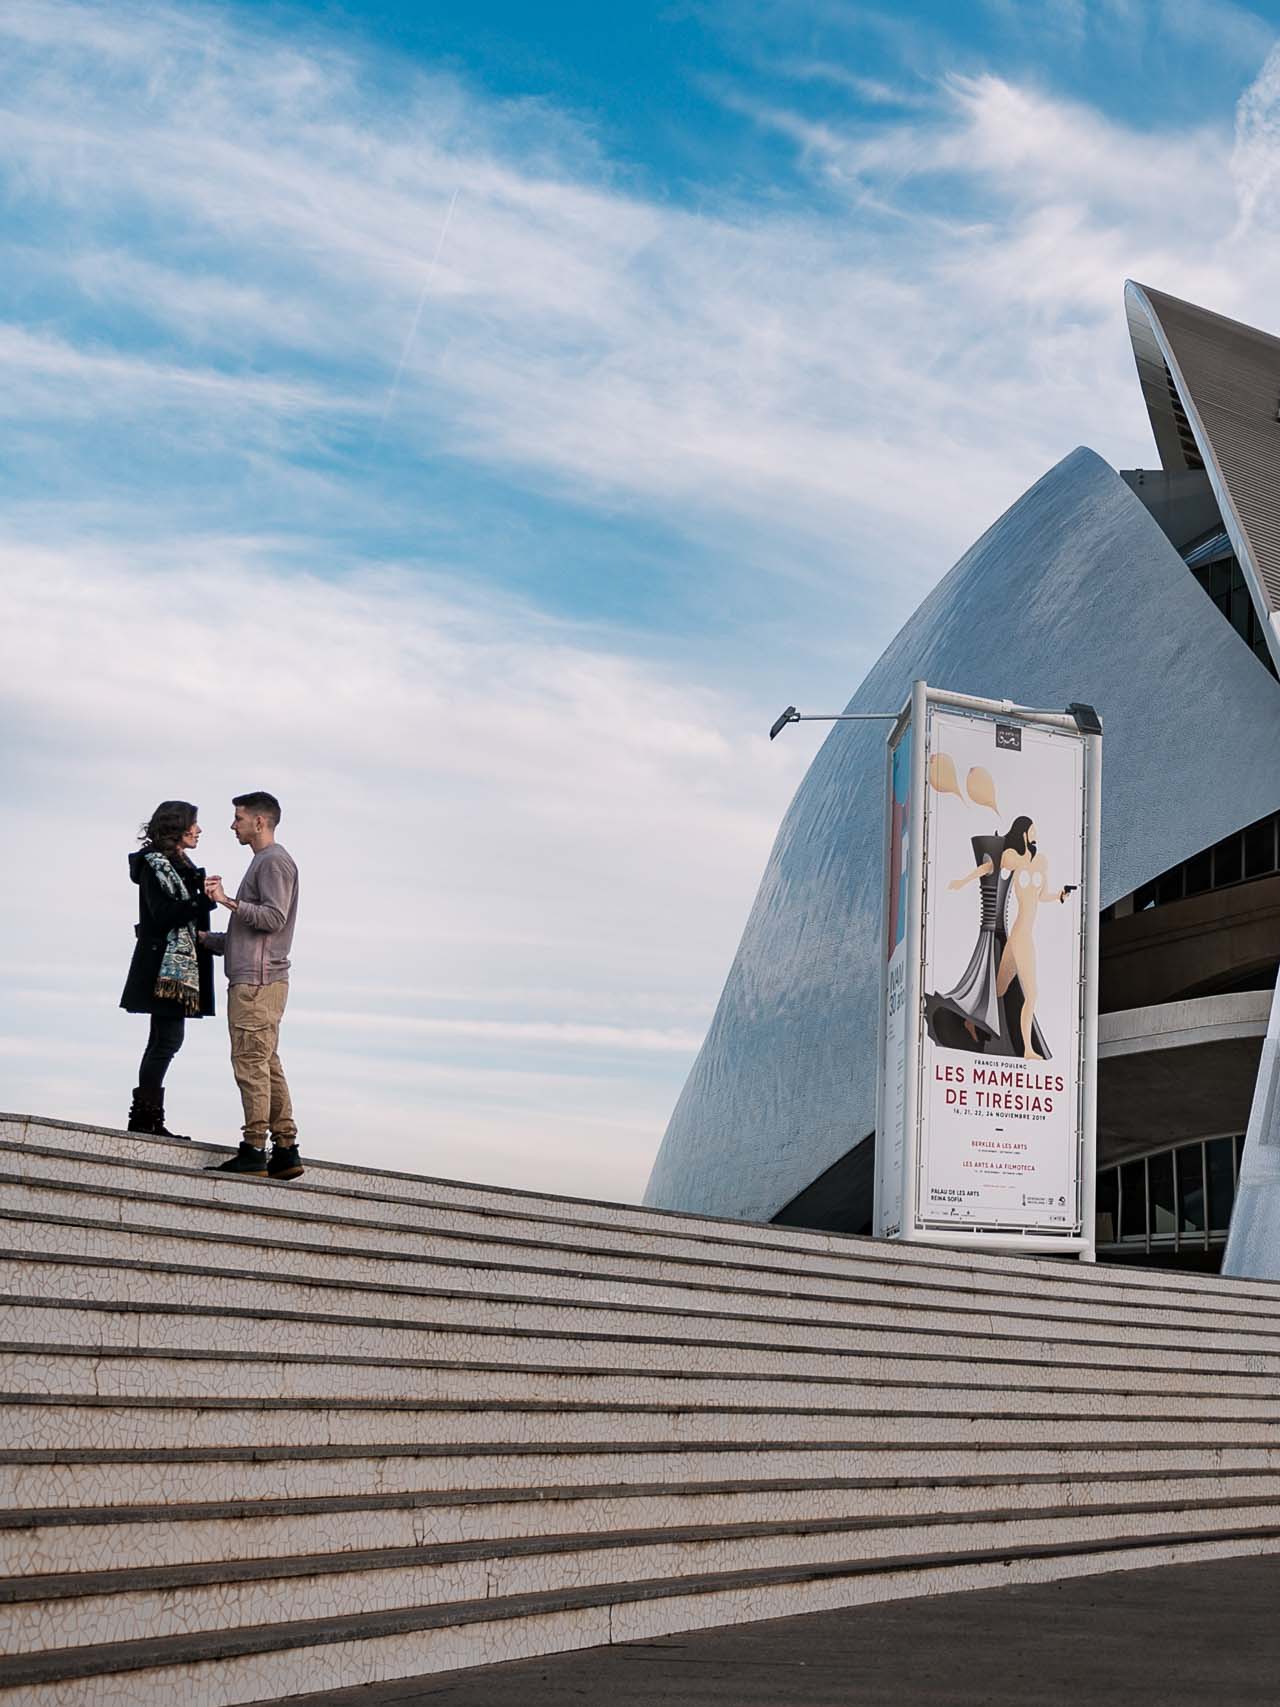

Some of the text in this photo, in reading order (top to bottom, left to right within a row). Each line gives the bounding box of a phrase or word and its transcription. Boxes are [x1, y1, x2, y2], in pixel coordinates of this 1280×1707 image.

[974, 1059, 1027, 1070] FRANCIS POULENC
[935, 1064, 1064, 1092] LES MAMELLES
[946, 1088, 1053, 1113] DE TIRÉSIAS
[996, 1112, 1030, 1120] NOVIEMBRE
[971, 1140, 995, 1149] BERKLEE
[1004, 1164, 1036, 1172] FILMOTECA
[931, 1187, 947, 1195] PALAU
